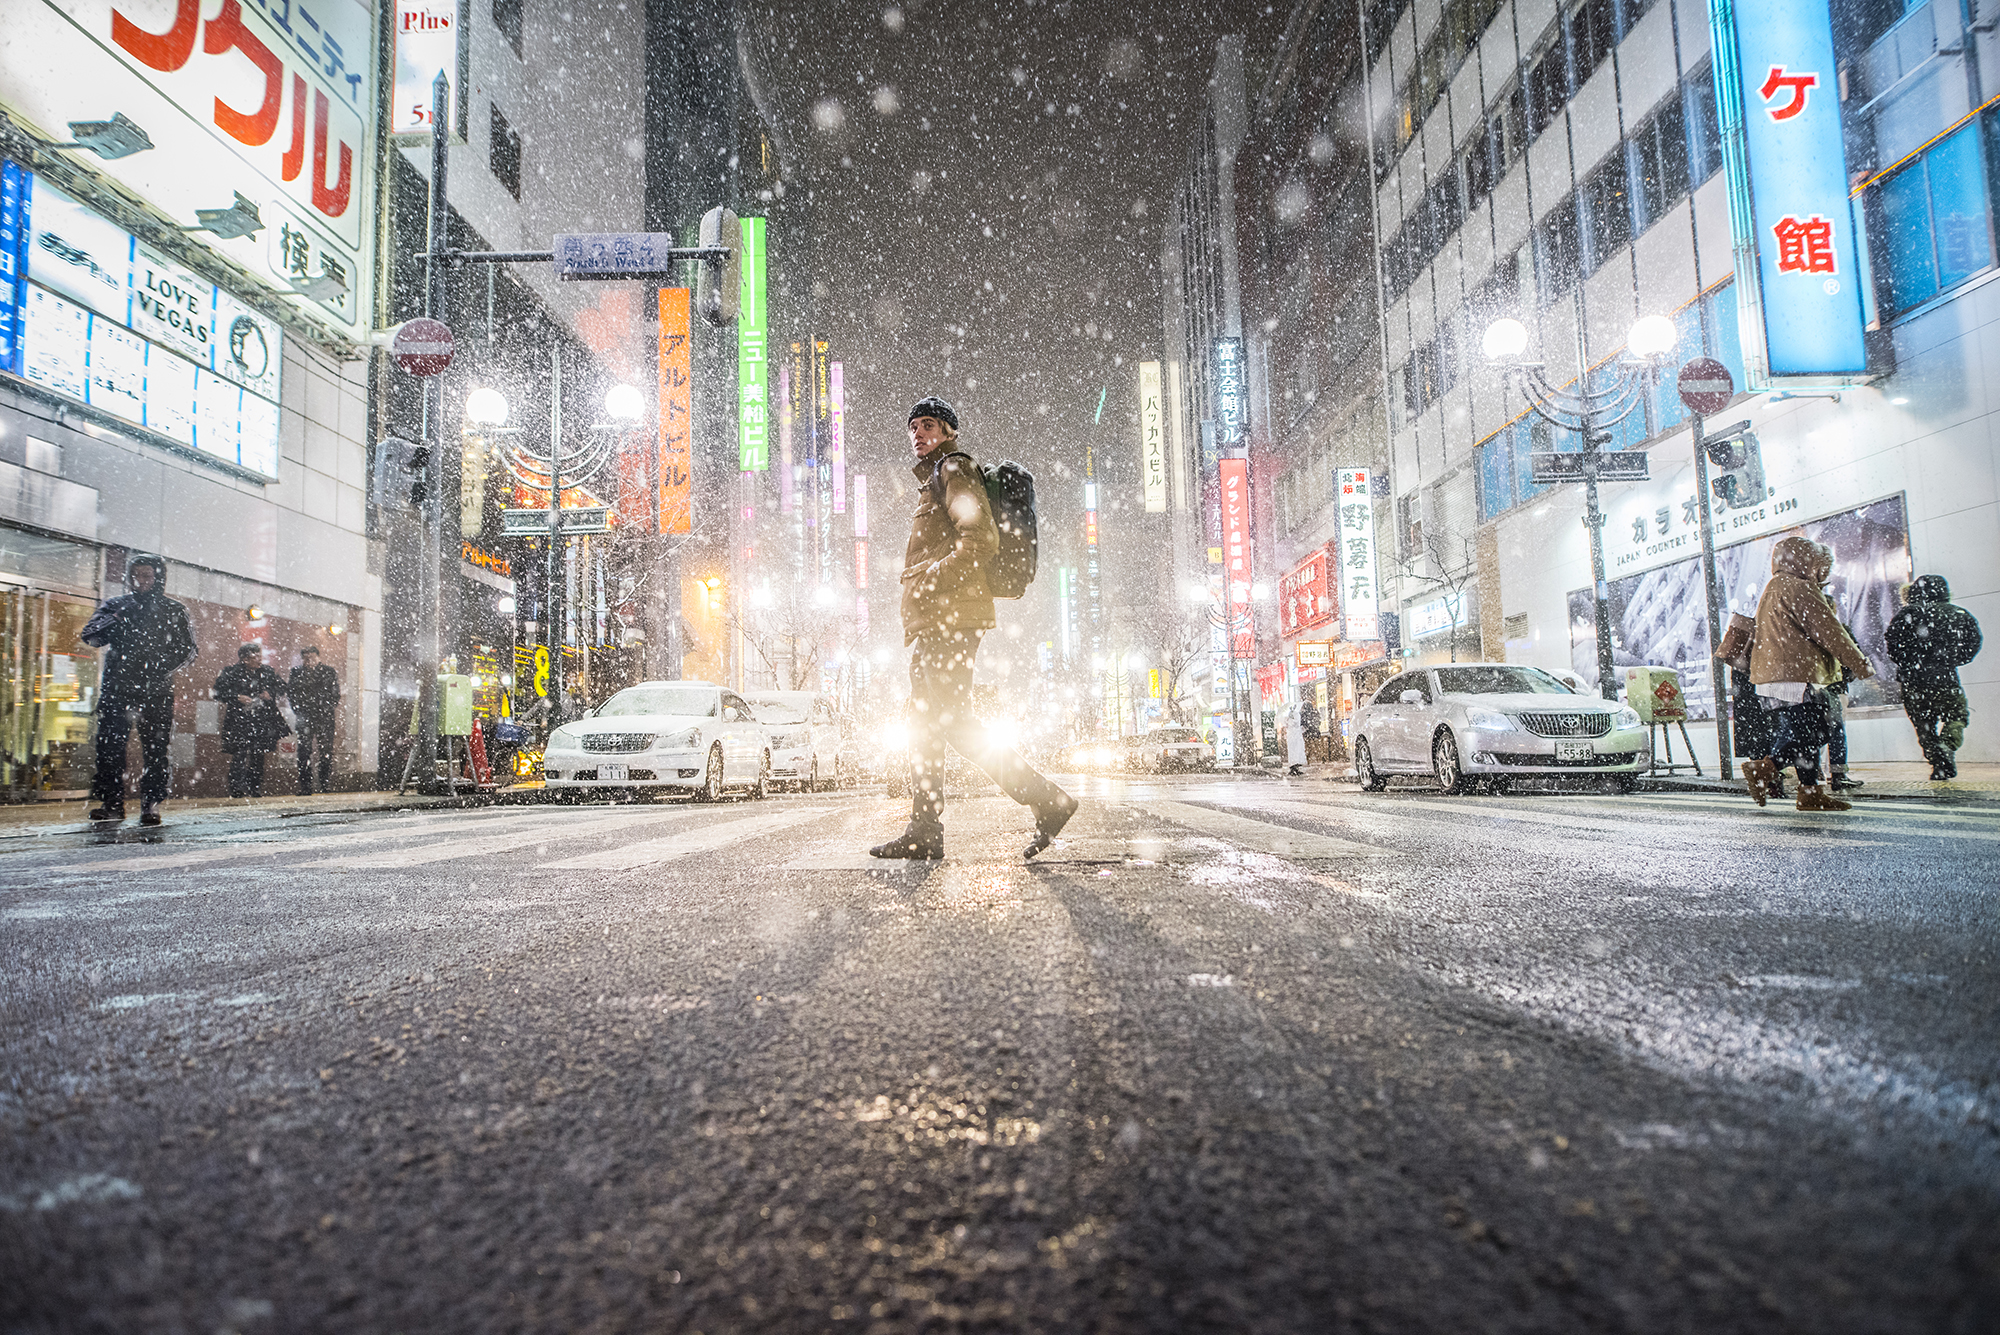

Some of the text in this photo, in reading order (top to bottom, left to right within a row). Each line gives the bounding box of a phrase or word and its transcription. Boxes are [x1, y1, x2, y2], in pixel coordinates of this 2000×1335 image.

[403, 12, 450, 32] Plus
[411, 104, 434, 125] 5
[136, 290, 208, 343] VEGAS
[145, 269, 199, 315] LOVE
[664, 332, 687, 487] アルトビル
[1218, 343, 1242, 443] 富士会館ビル
[1145, 395, 1163, 487] バッカスビル
[1616, 549, 1642, 567] JAPAN
[1645, 536, 1688, 556] COUNTRY
[1693, 520, 1727, 543] SIT
[1732, 508, 1766, 528] SINCE
[1563, 748, 1592, 760] 55-88
